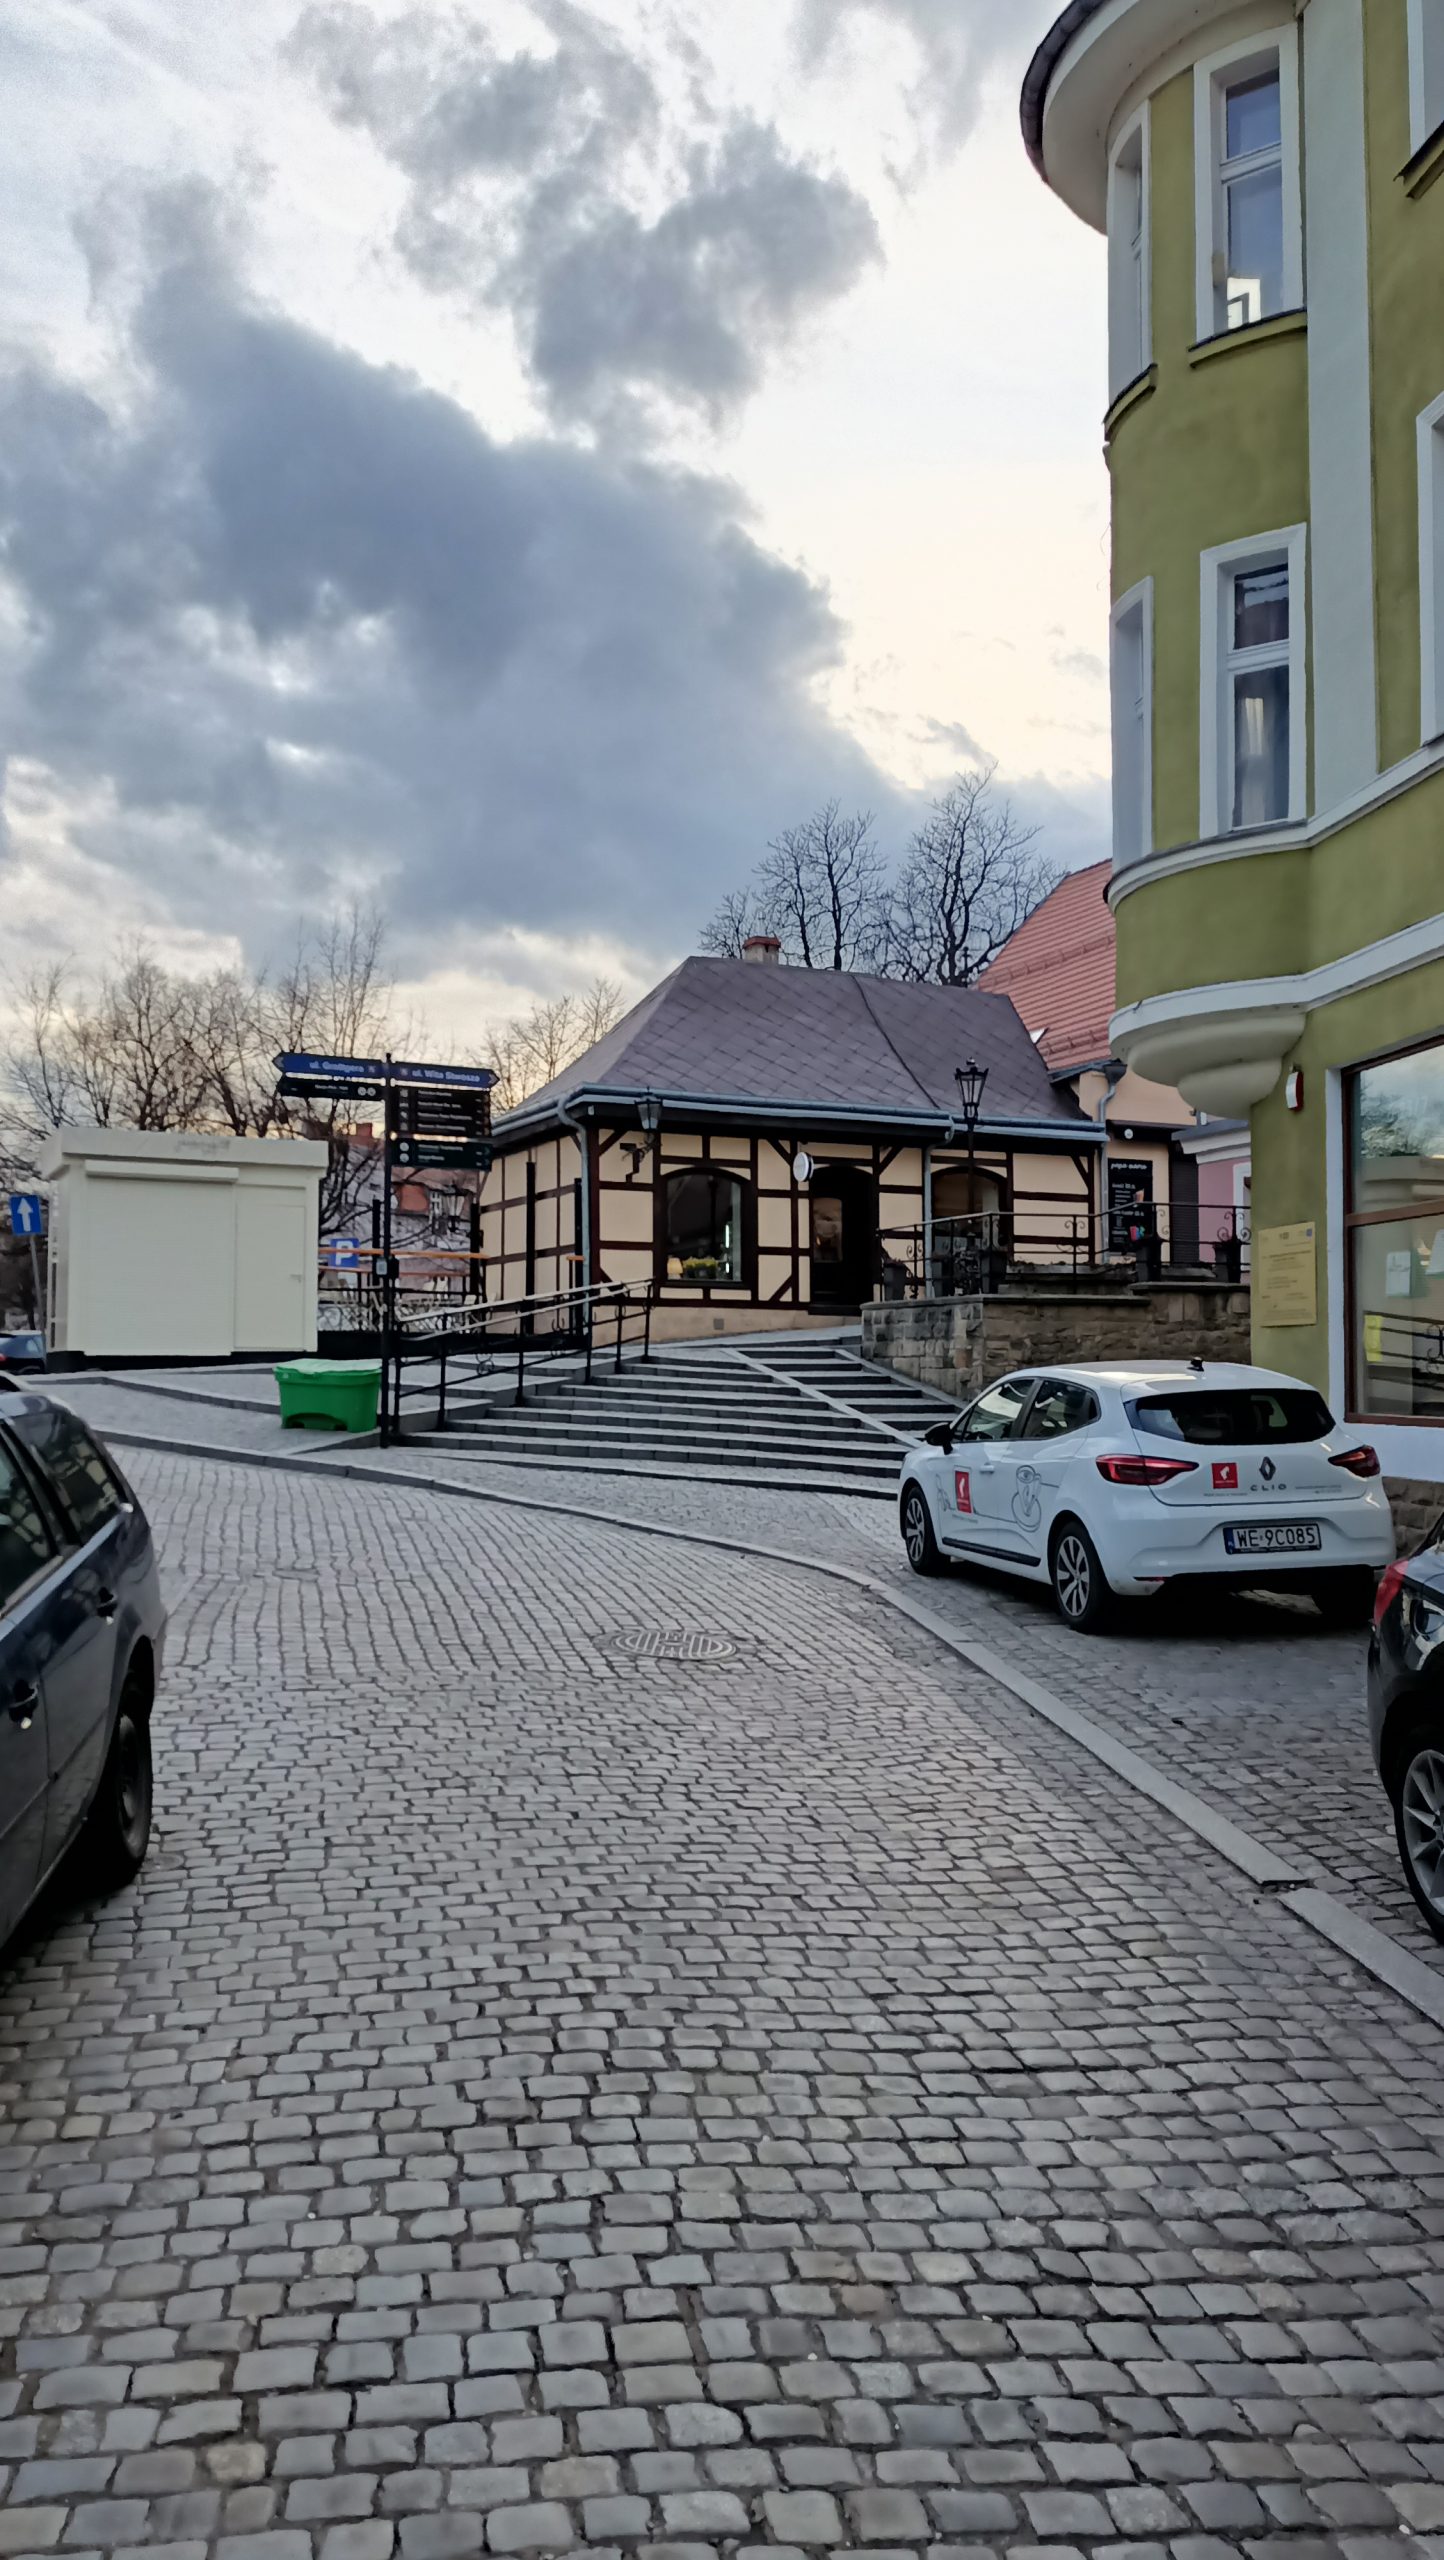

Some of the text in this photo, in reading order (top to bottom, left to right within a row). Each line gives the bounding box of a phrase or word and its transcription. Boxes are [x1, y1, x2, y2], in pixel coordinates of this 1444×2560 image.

[335, 1240, 354, 1265] P
[1250, 1483, 1287, 1492] CLIO
[1237, 1527, 1316, 1547] WE 9C085
